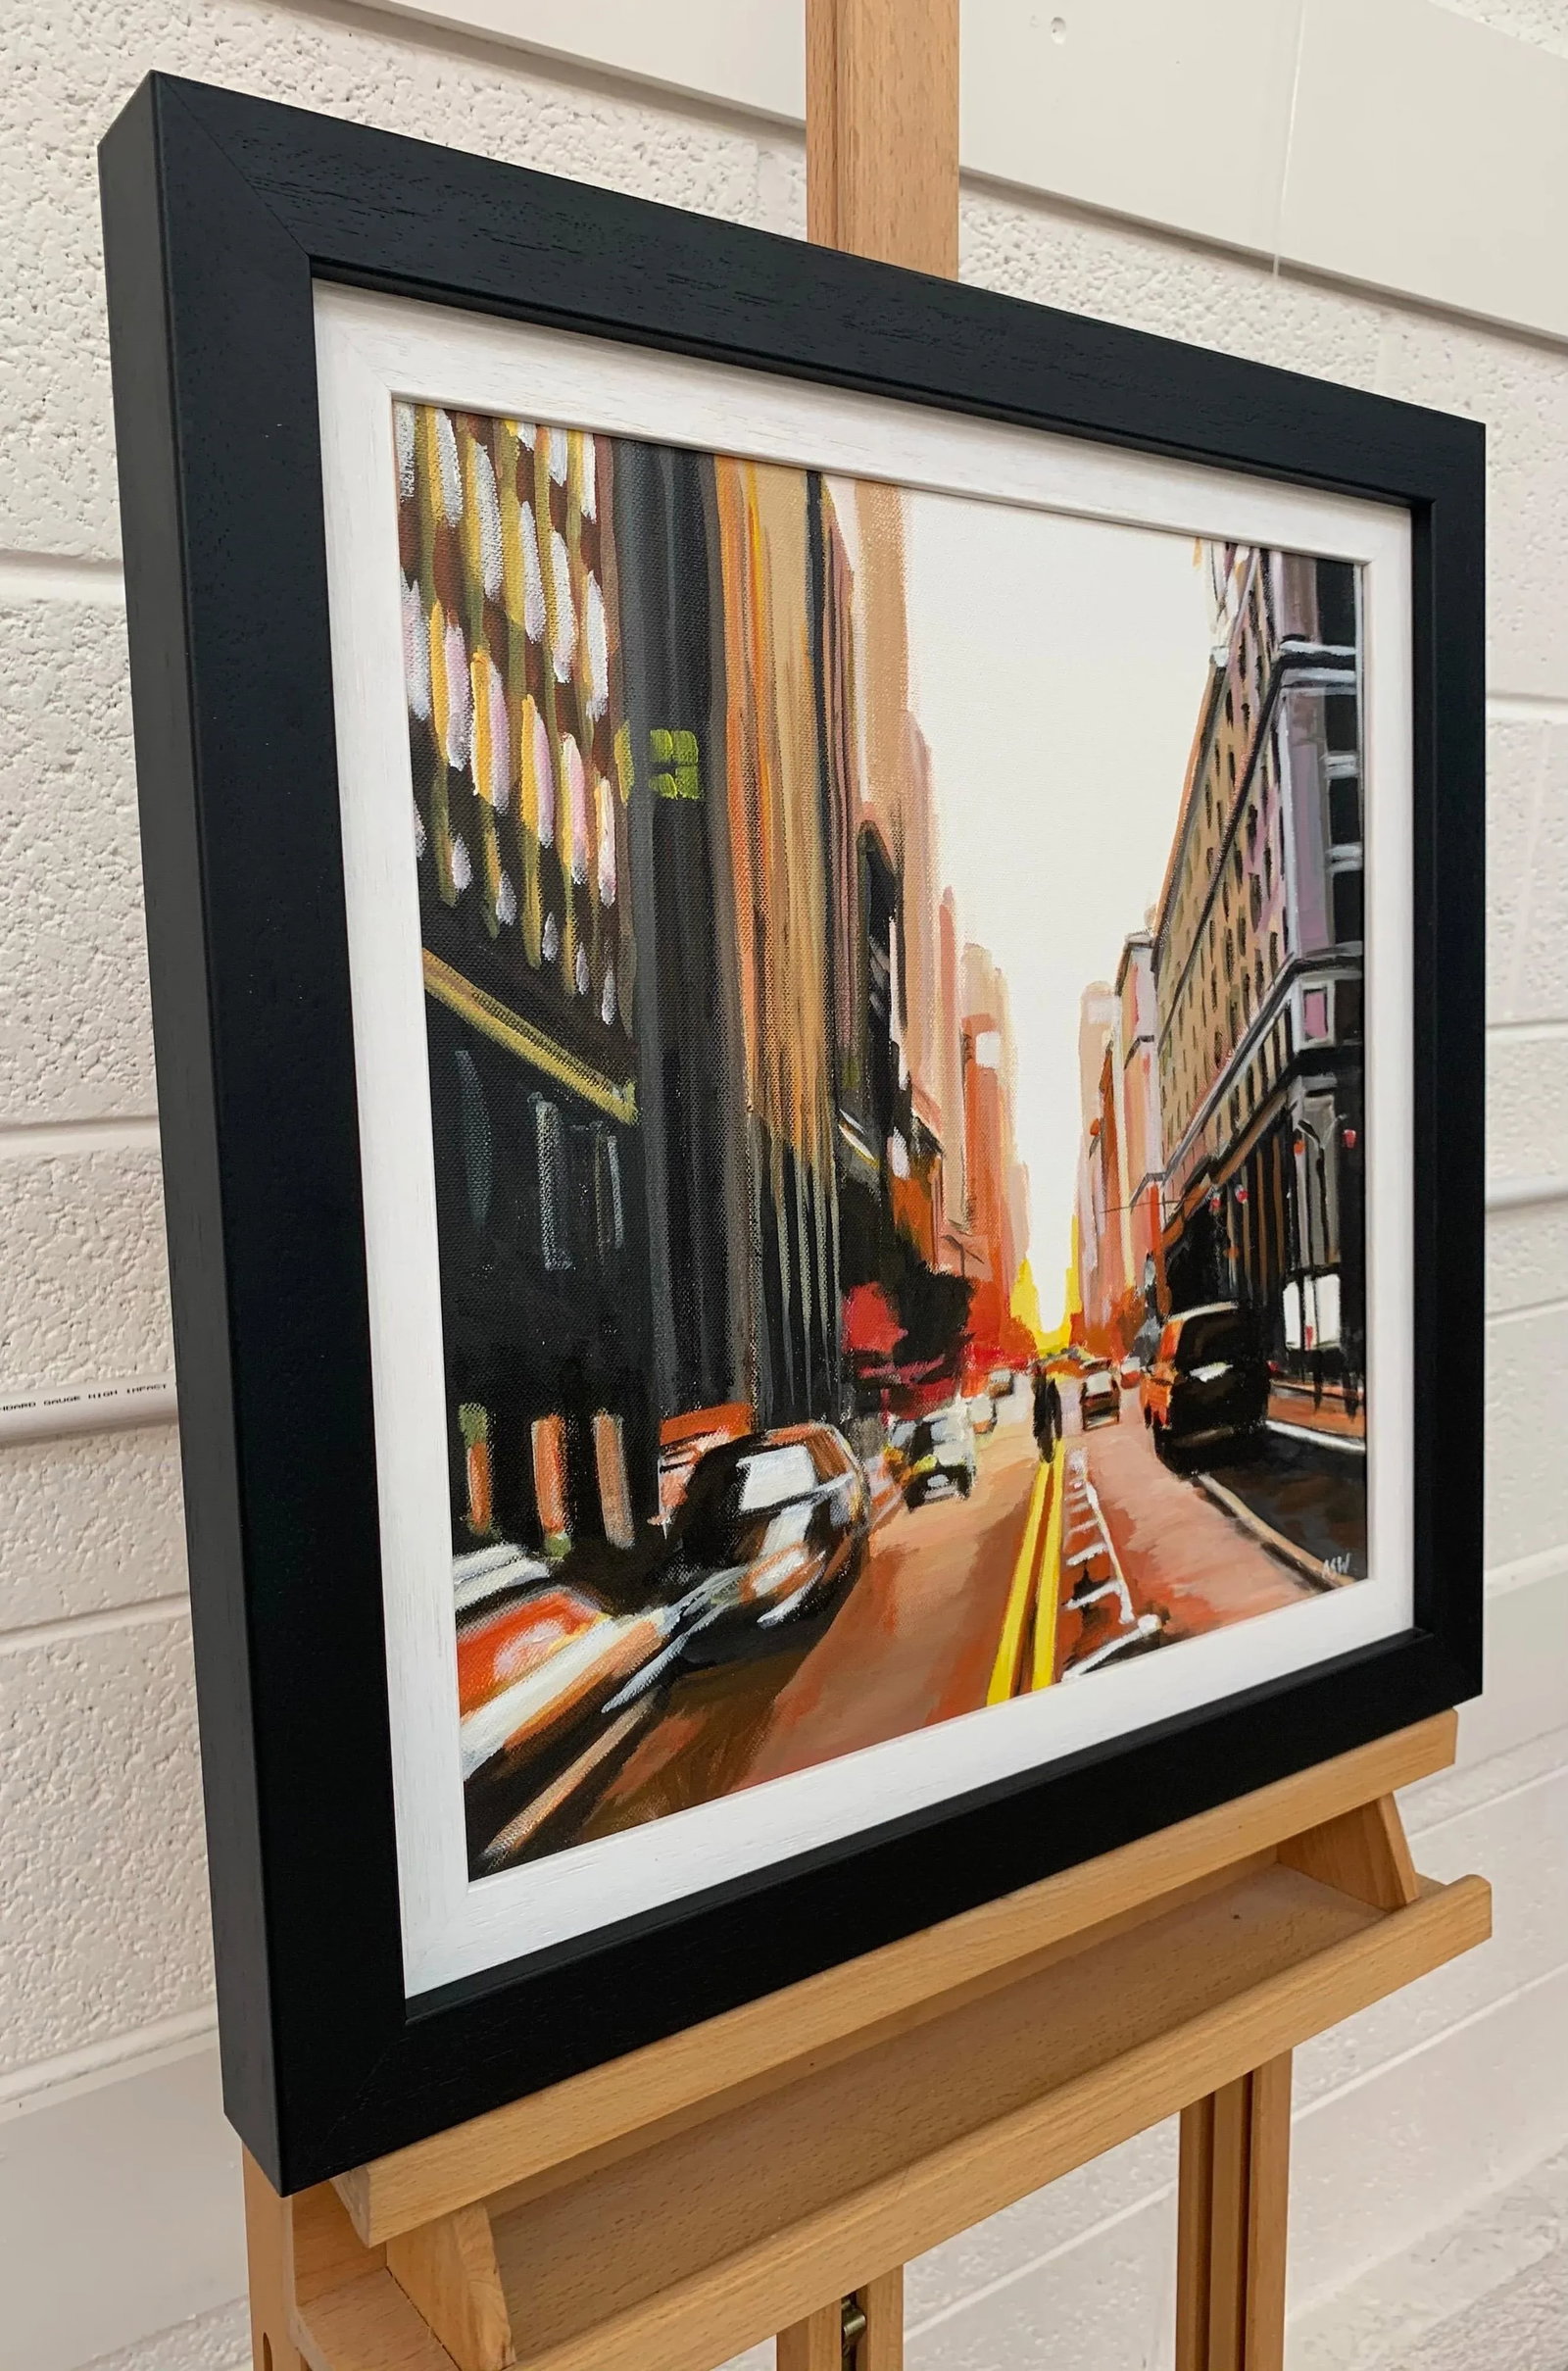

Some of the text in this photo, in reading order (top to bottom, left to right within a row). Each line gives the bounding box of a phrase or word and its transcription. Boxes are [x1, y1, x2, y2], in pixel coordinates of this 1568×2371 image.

[43, 1395, 80, 1407] GAUGE
[88, 1390, 119, 1400] HIGH
[126, 1383, 168, 1394] IMPACT
